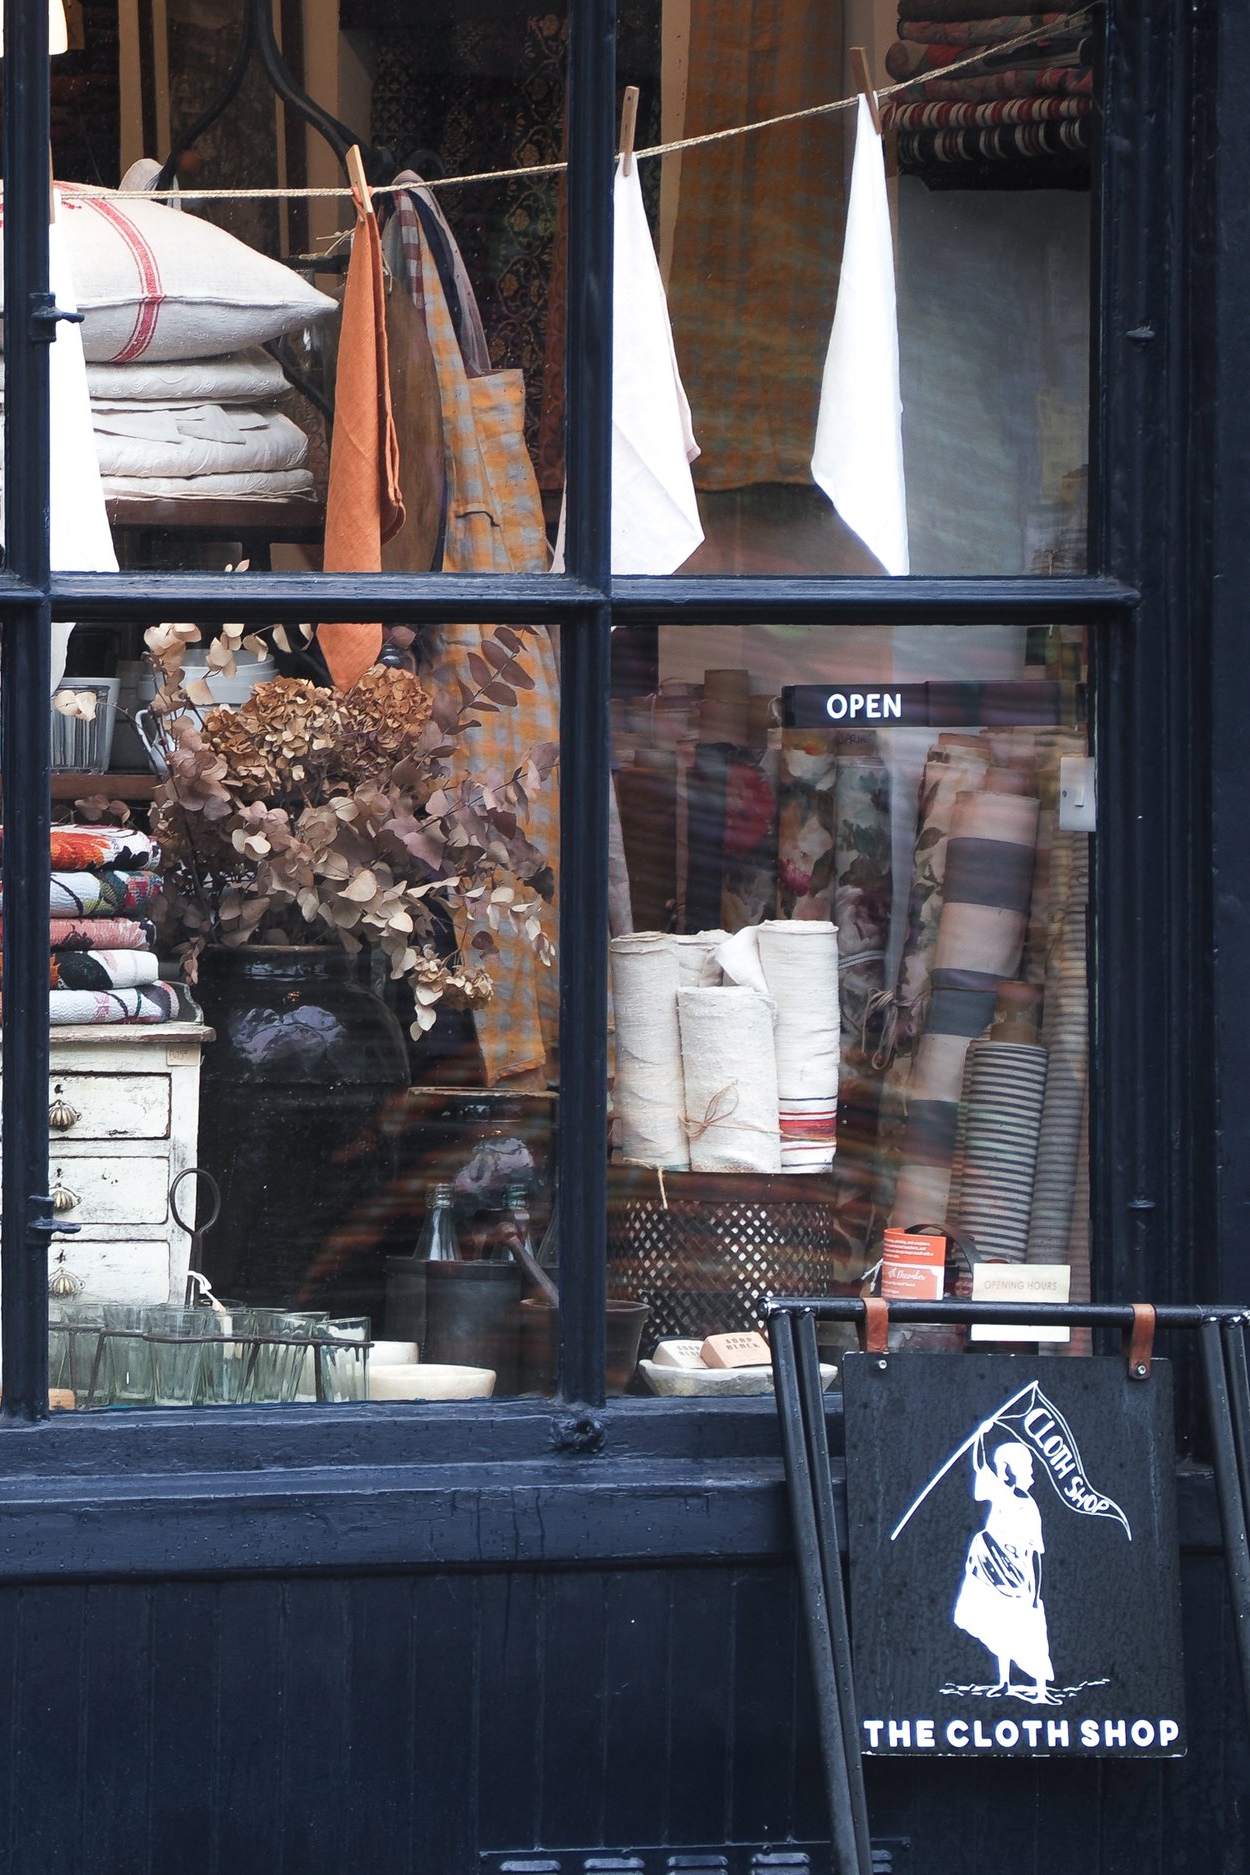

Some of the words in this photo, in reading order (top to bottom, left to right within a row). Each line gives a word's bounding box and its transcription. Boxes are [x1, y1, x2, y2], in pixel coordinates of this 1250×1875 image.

[826, 693, 902, 719] OPEN
[983, 1280, 1025, 1290] OPENING
[1027, 1281, 1057, 1291] HOURS
[1024, 1407, 1076, 1480] CLOTH
[1064, 1476, 1110, 1513] SHOP
[863, 1719, 935, 1748] THE
[946, 1719, 1070, 1748] CLOTH
[1080, 1719, 1179, 1748] SHOP
